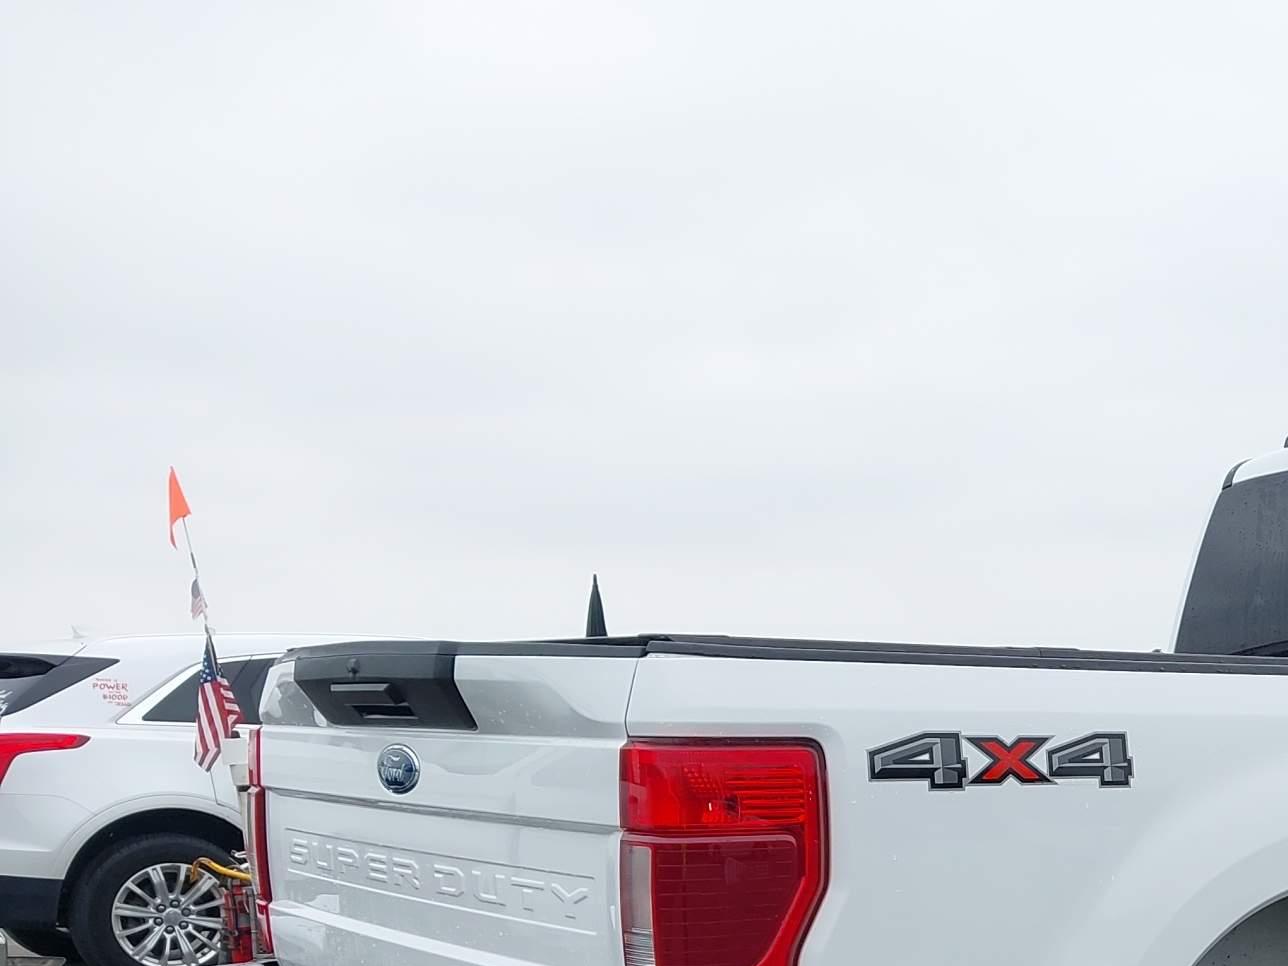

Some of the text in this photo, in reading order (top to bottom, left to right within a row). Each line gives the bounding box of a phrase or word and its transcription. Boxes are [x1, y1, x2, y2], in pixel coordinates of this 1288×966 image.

[92, 682, 128, 691] POWER
[288, 837, 589, 920] SUPER DUTY
